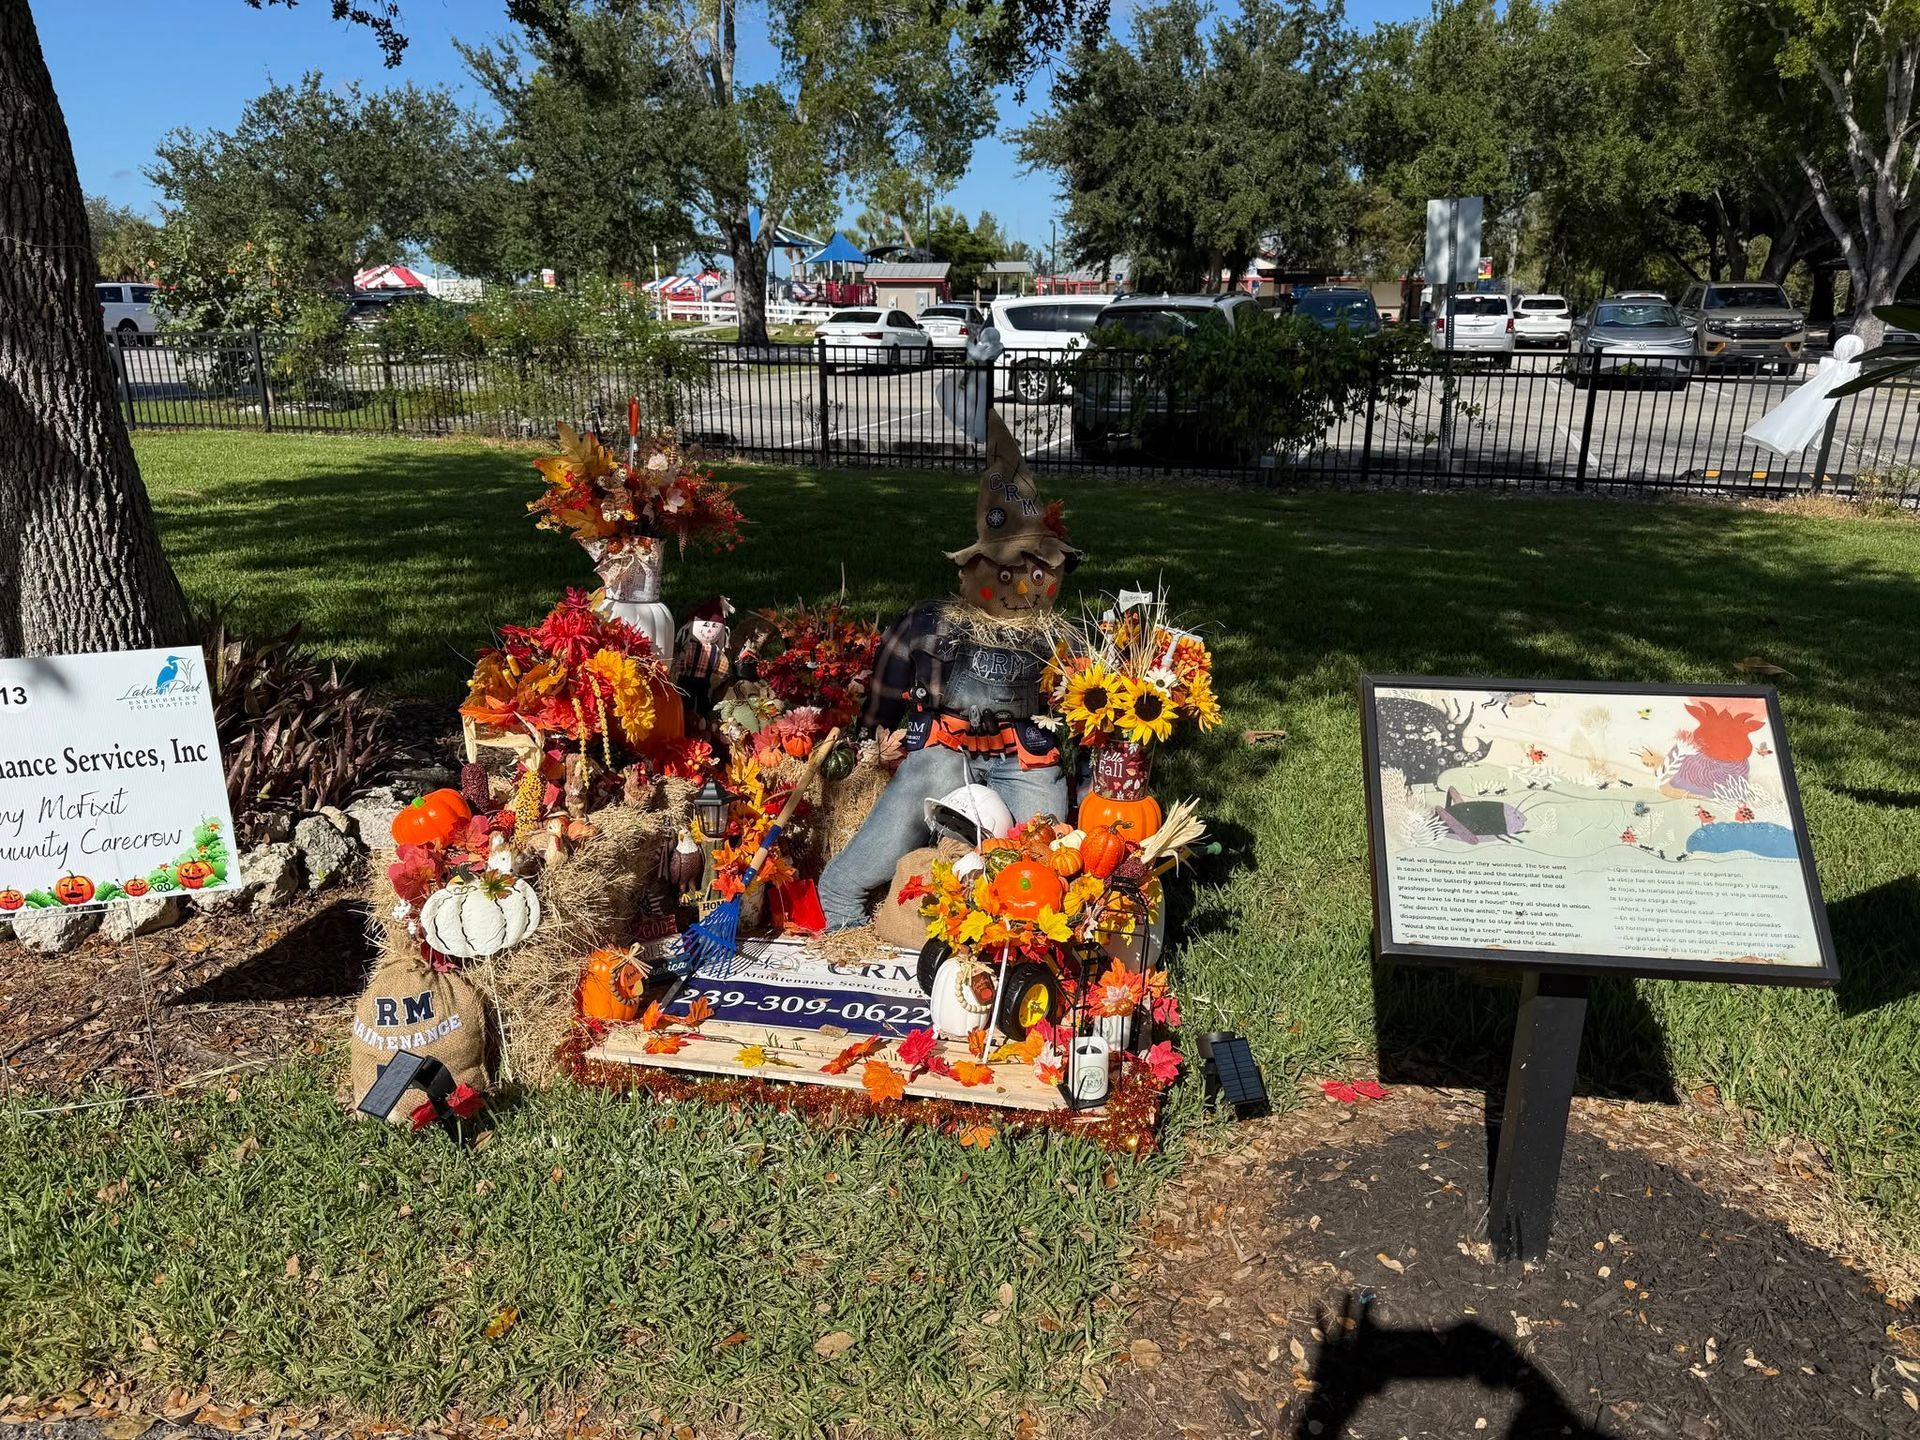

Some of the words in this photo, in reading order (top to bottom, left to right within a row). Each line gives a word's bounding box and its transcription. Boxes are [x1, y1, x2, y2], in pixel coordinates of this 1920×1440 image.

[989, 472, 1039, 517] CRM
[972, 650, 1026, 676] CRM
[0, 687, 27, 705] 13
[166, 680, 202, 694] Park
[130, 701, 197, 711] FOUNDATION
[63, 743, 165, 773] Services,
[170, 738, 208, 764] Inc
[1098, 760, 1123, 778] Fall
[38, 787, 129, 823] McFixit
[80, 827, 182, 855] Carecrow
[742, 972, 835, 987] Maintenance
[375, 990, 435, 1027] RM
[673, 989, 931, 1026] 239-309-0622
